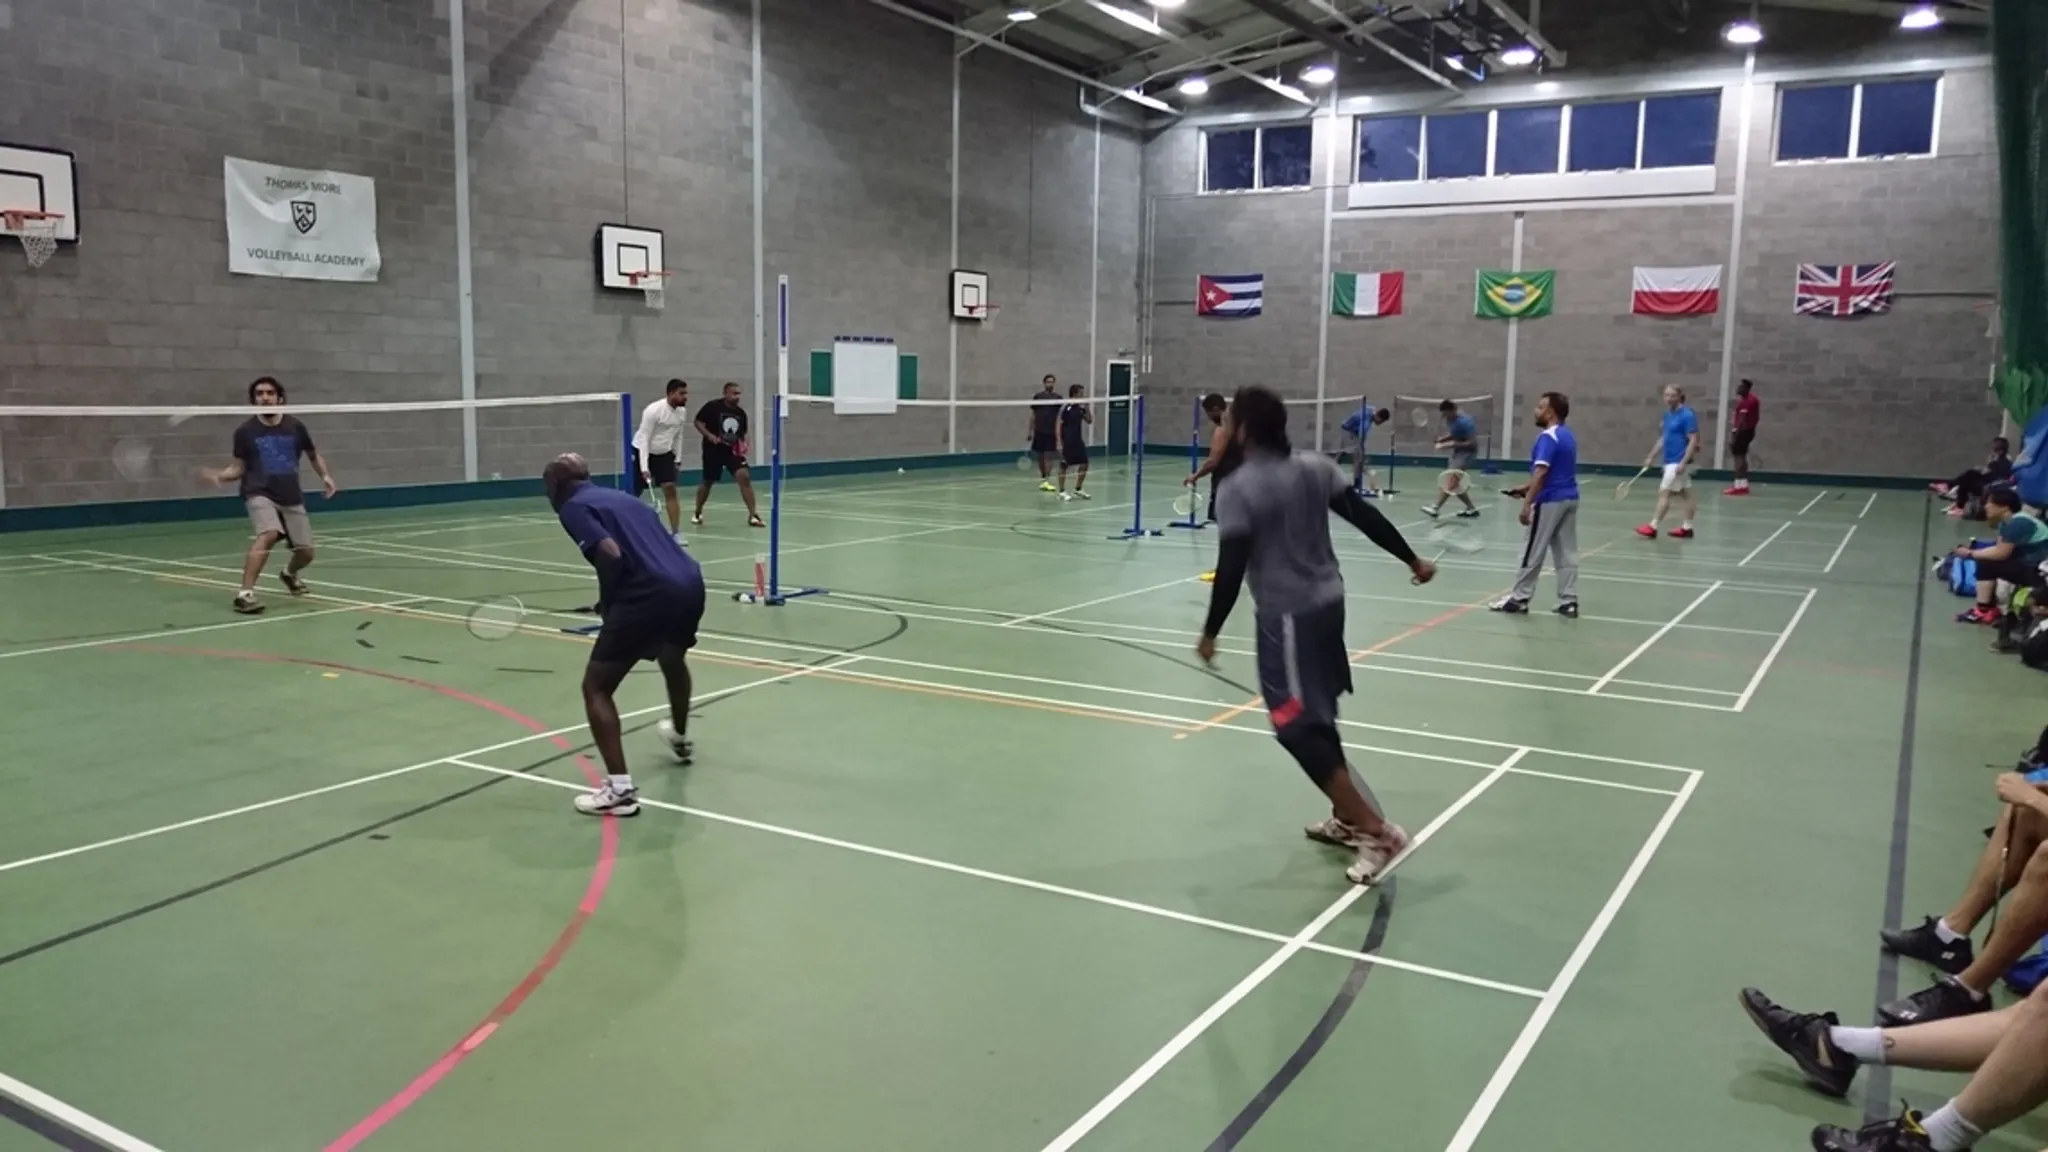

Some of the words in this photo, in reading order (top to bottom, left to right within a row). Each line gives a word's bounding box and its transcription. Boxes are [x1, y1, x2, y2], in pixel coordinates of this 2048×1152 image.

[265, 176, 309, 191] THOMAS
[311, 181, 342, 195] MORE
[247, 247, 312, 263] VOLLEYBALL
[314, 253, 365, 267] ACADEMY
